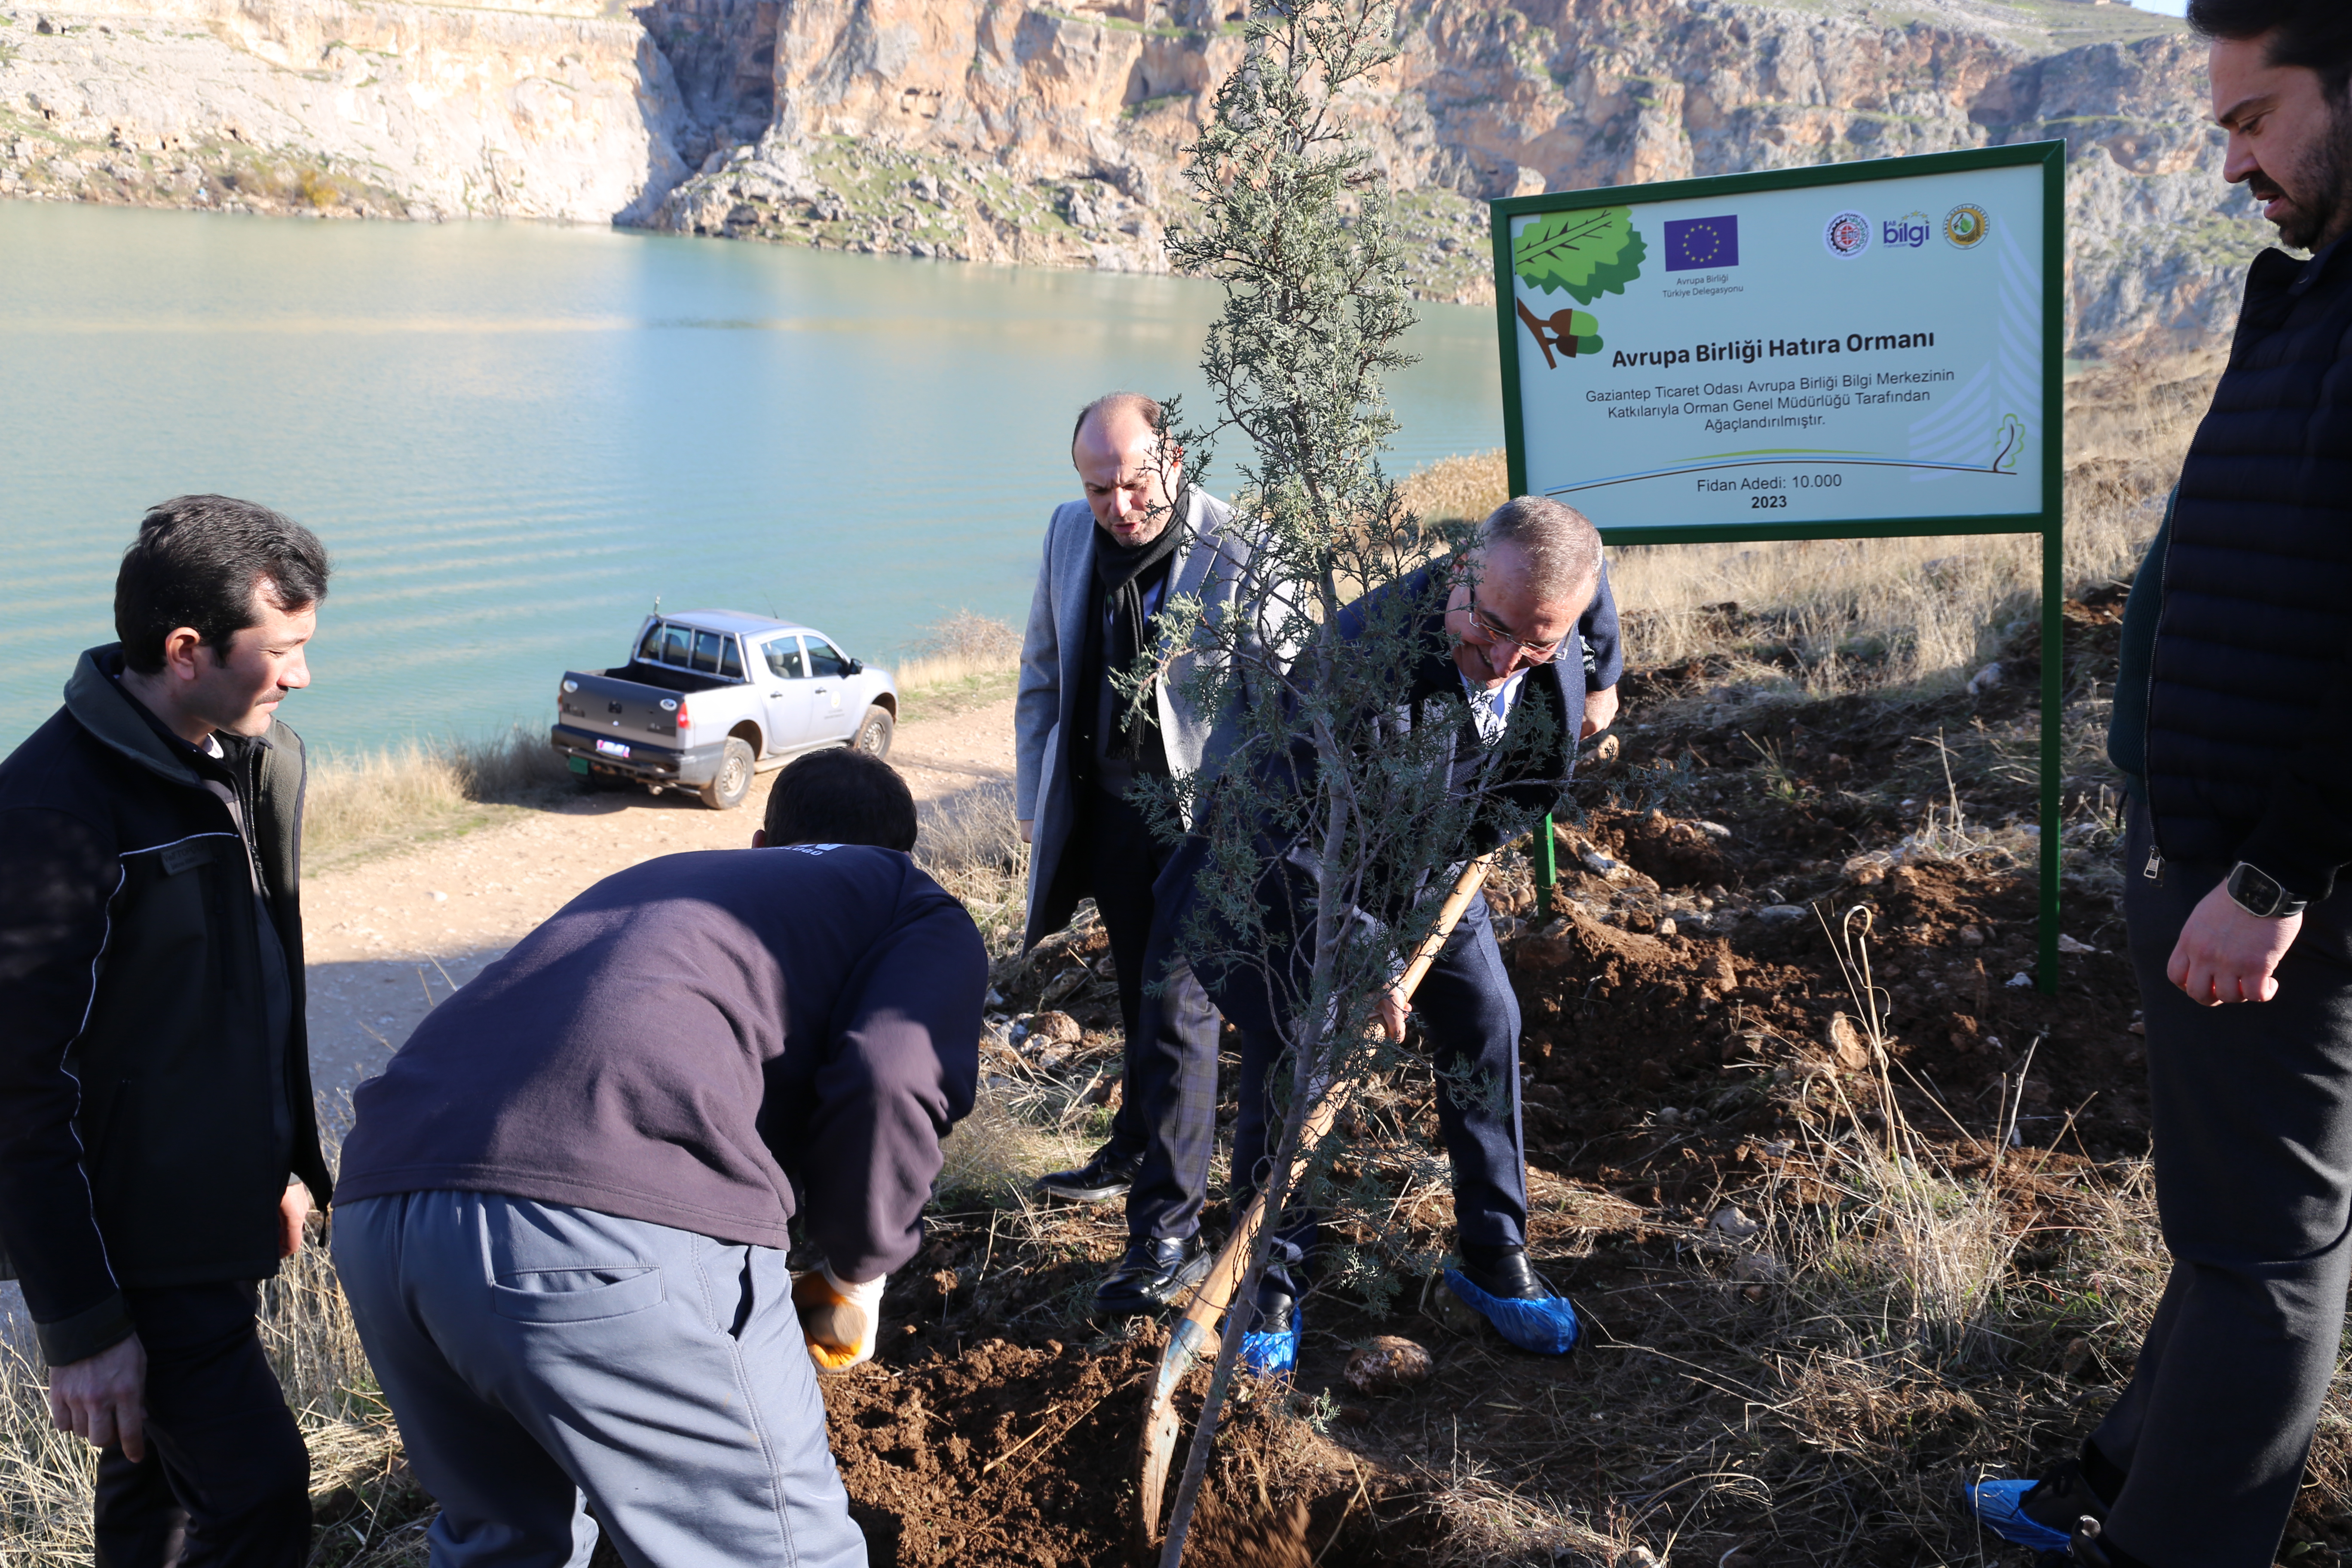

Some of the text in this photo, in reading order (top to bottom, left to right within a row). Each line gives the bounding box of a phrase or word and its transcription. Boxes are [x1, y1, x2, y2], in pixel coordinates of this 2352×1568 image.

[1883, 220, 1930, 248] bilgi
[1676, 274, 1729, 286] Avrupa Birliği
[1662, 285, 1744, 298] Türkiye Delegasyonu
[1612, 332, 1935, 369] Avrupa Birliği Hatıra Ormanı
[1586, 368, 1954, 402] Gaziantep Ticaret Odası Avrupa Birliği Bilgi Merkezinin
[1608, 389, 1930, 419] Katkılarıyla Orman Genel Müdürlüğü Tarafından
[1704, 414, 1825, 434] Ağaçlandırılmıştır.
[1697, 474, 1842, 492] Fidan Adedi: 10.000
[1751, 495, 1788, 509] 2023
